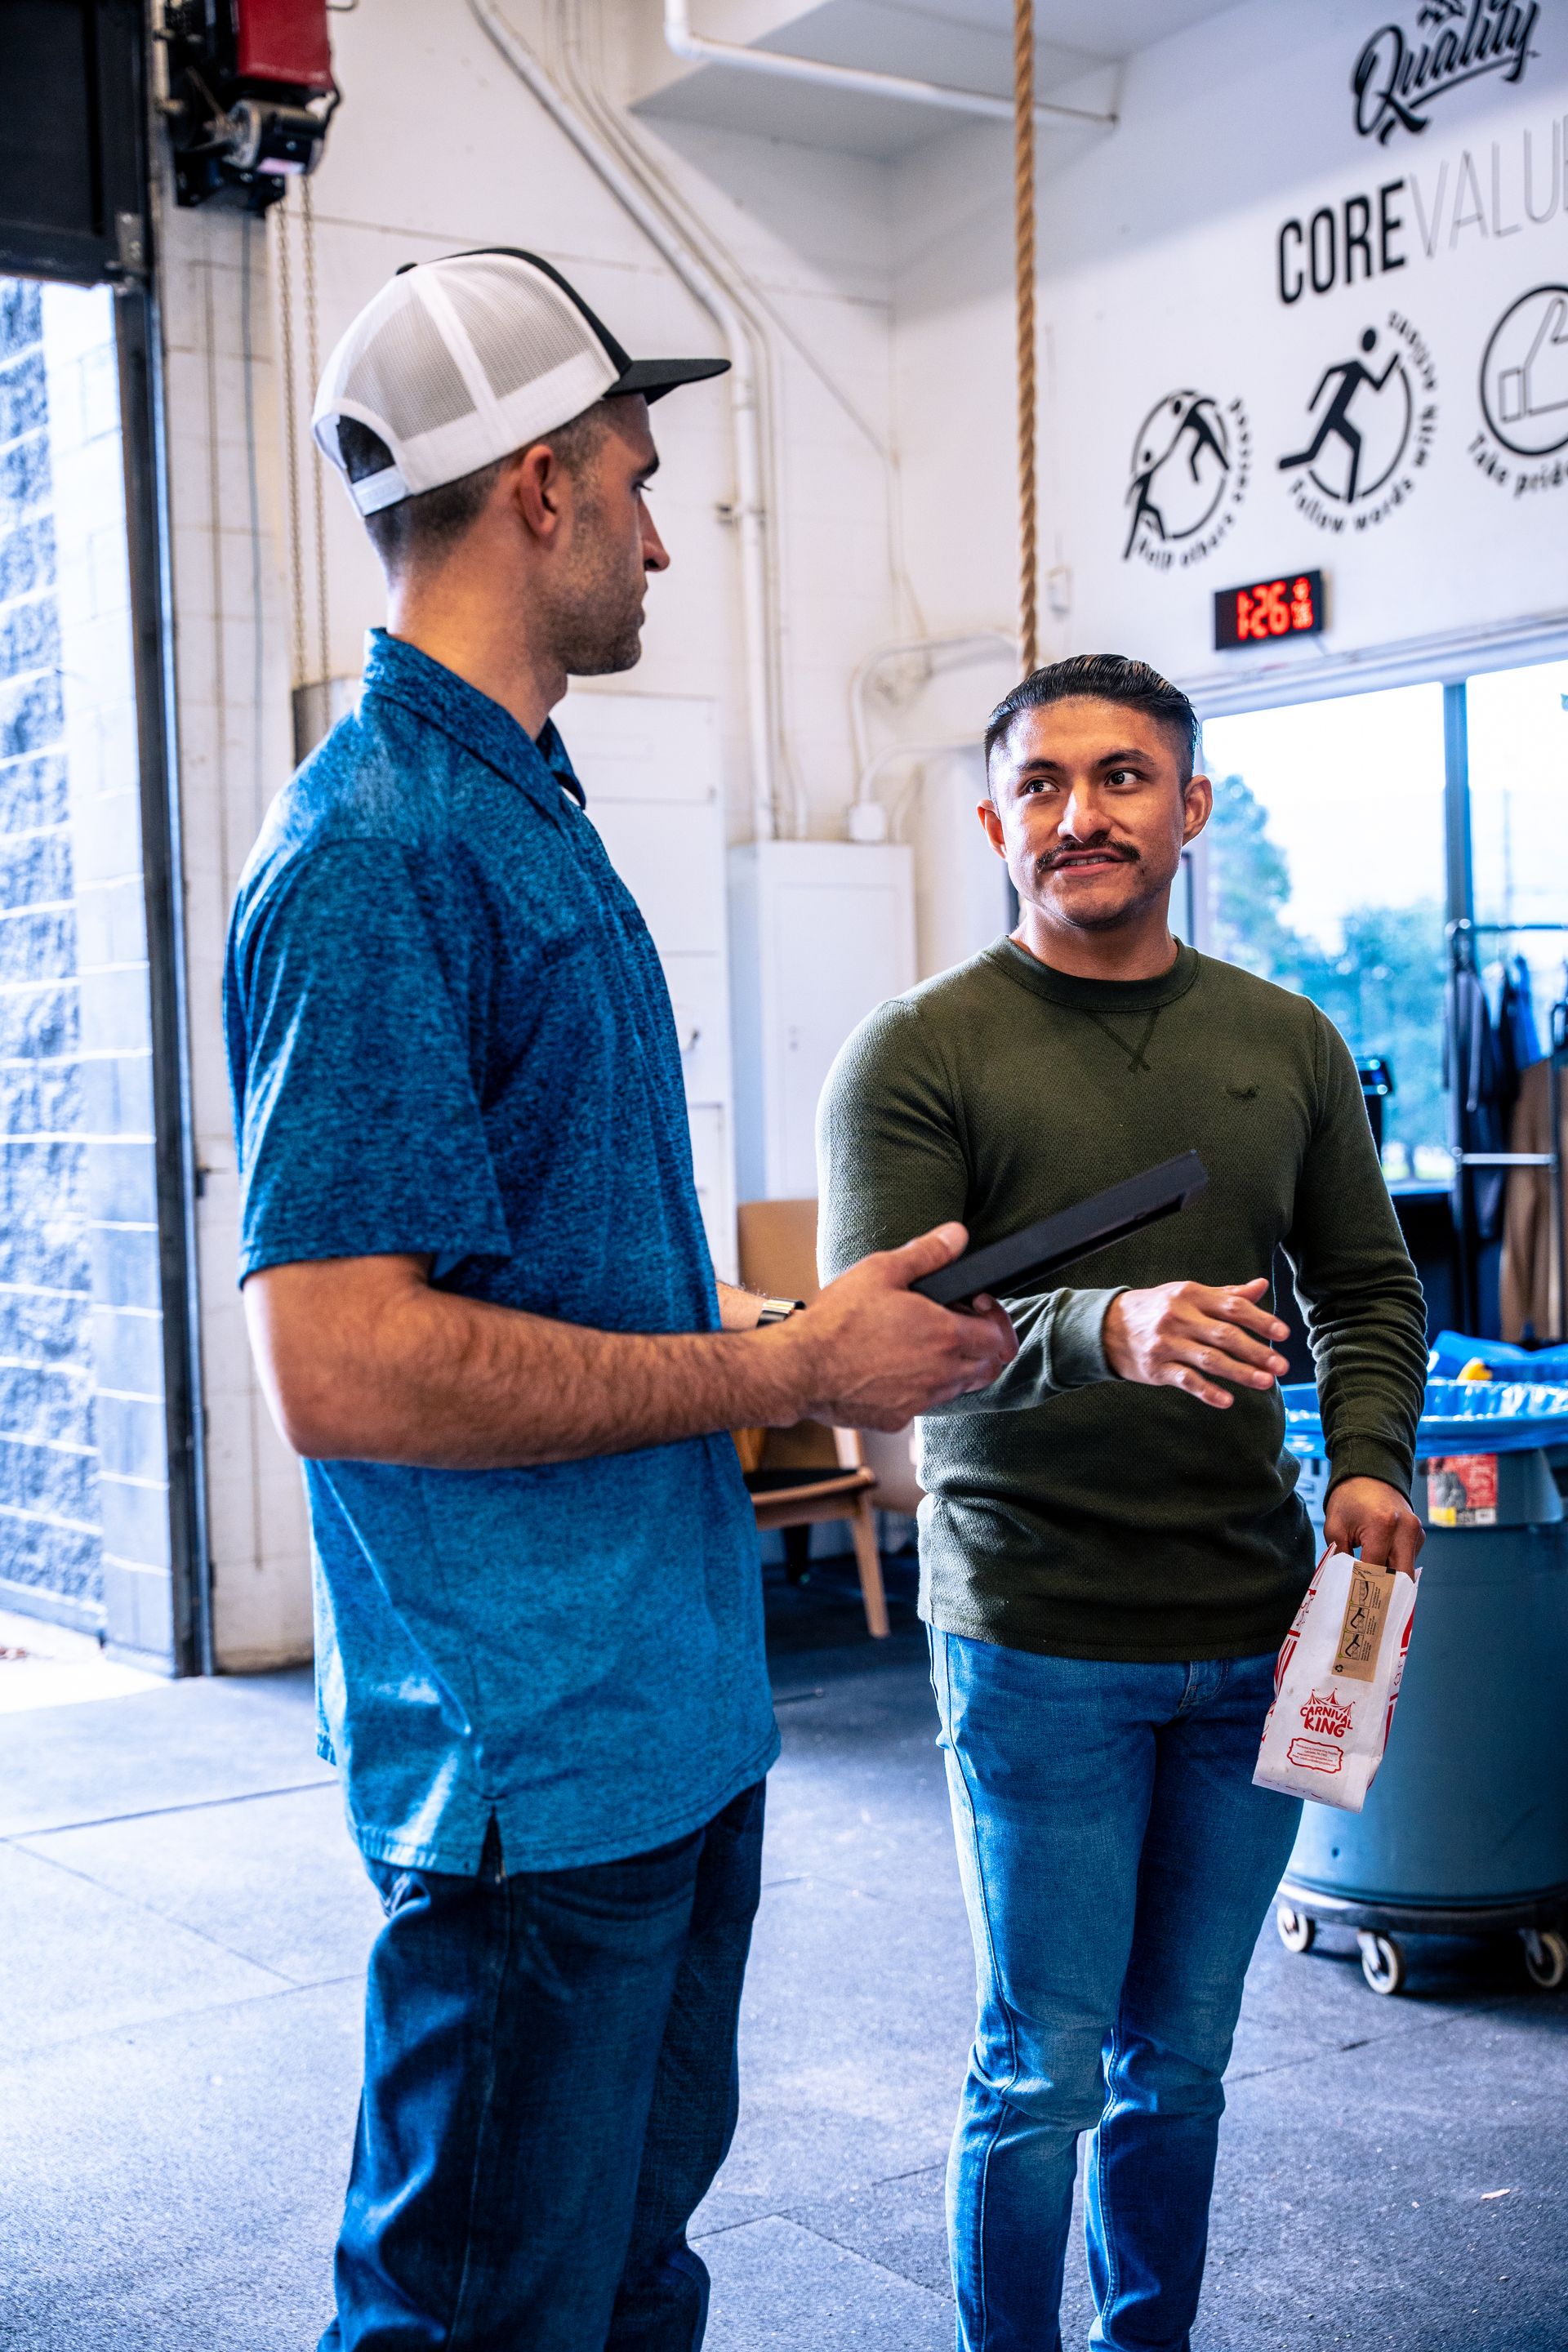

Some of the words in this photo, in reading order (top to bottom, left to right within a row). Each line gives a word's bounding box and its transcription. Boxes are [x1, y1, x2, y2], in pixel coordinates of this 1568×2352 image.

[1351, 0, 1541, 146] Quality
[1277, 177, 1405, 305] CORE
[1410, 116, 1568, 260] VALU
[1468, 431, 1508, 485] Take
[1514, 461, 1568, 500] prid
[1300, 1706, 1353, 1730] CARNIVAL
[1303, 1713, 1345, 1738] KING
